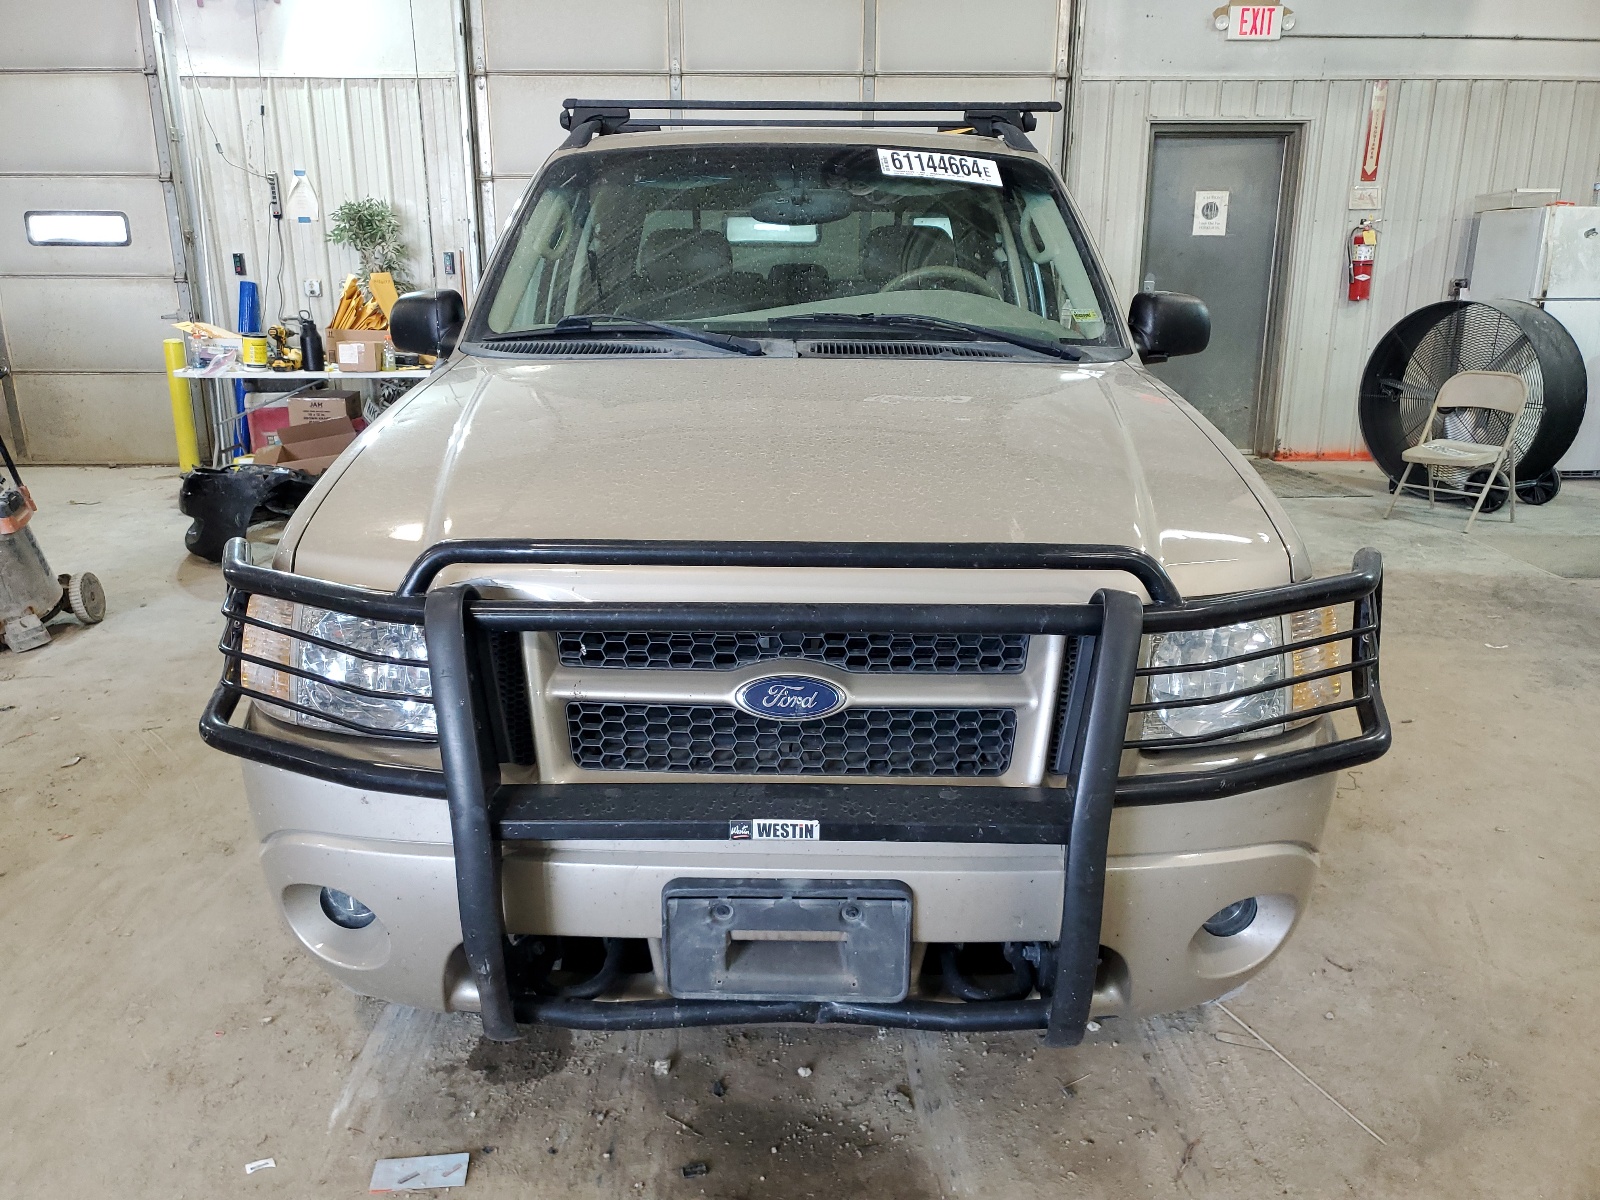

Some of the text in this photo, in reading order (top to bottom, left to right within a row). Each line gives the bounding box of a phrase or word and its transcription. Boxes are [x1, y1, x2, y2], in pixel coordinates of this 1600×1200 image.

[1239, 8, 1276, 35] EXIT
[890, 151, 982, 178] 61144664
[983, 166, 992, 178] E
[762, 684, 819, 709] Ford
